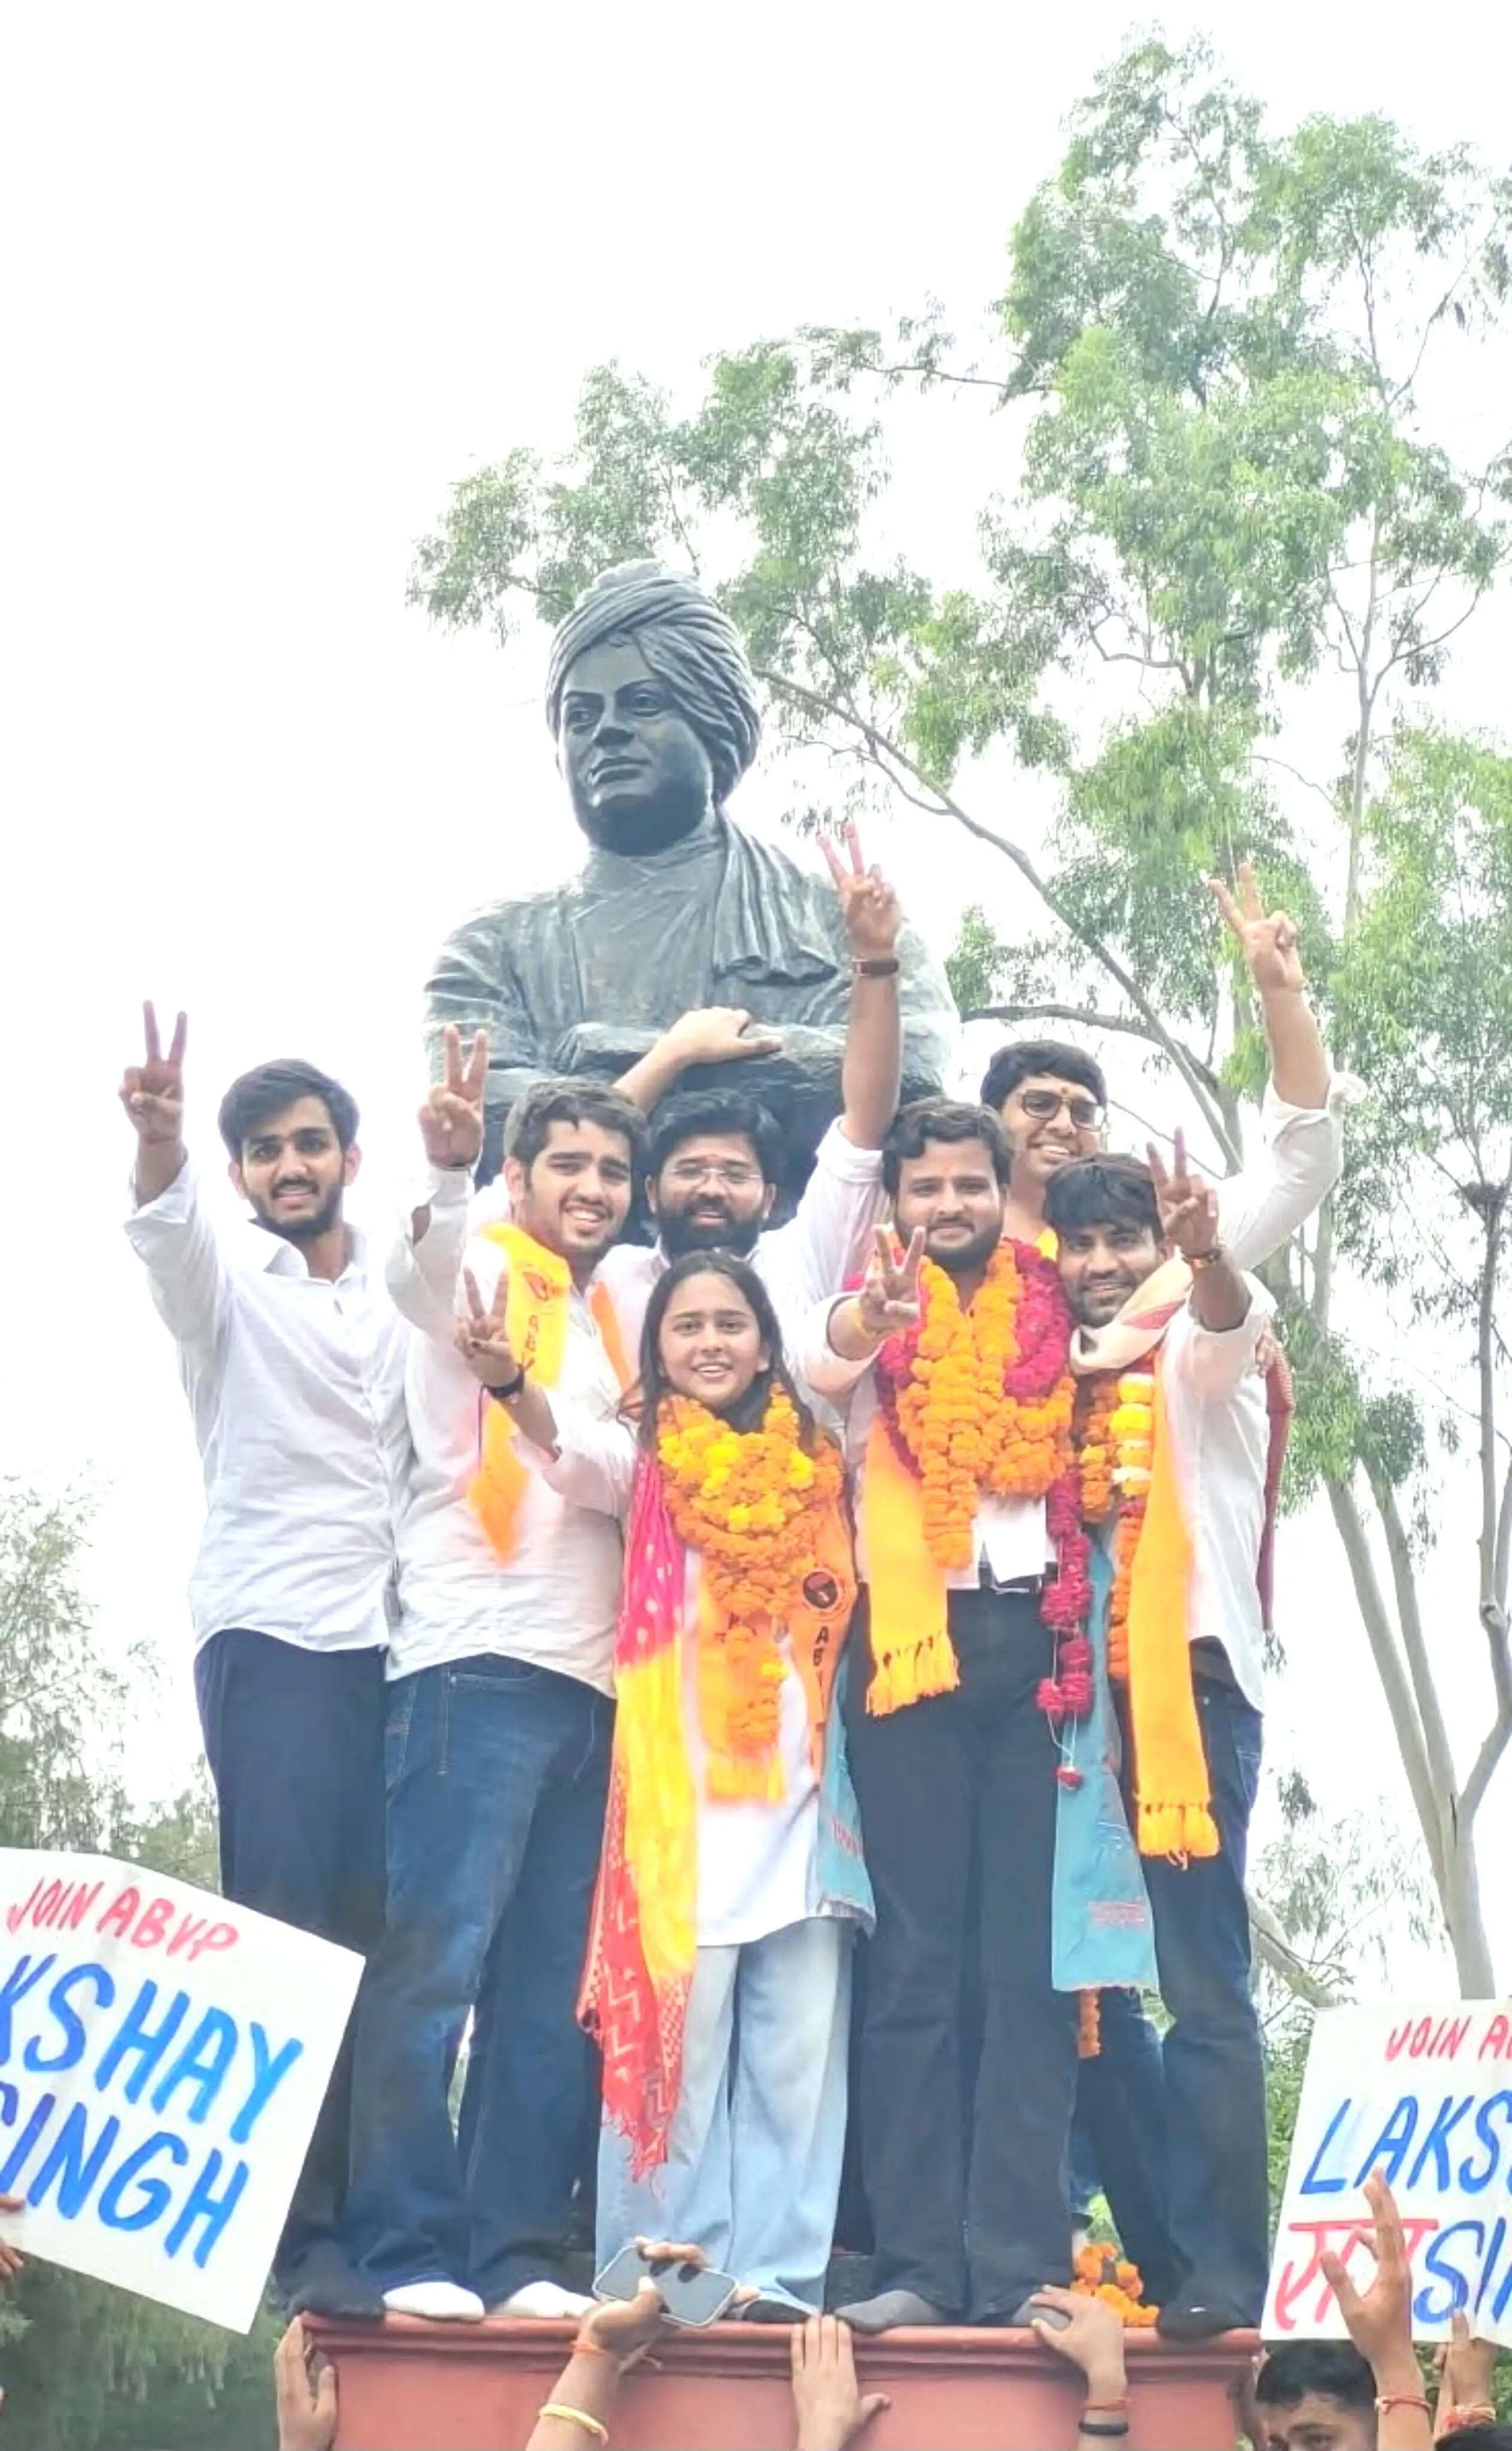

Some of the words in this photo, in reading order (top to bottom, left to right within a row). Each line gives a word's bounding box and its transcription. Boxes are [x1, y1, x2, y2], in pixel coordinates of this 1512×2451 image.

[8, 1877, 103, 1933] JOIN
[96, 1886, 239, 1962] ABVP
[0, 1953, 303, 2144] KSHAY
[1385, 2015, 1472, 2061] JOIN
[1478, 2014, 1512, 2060] A
[1300, 2090, 1512, 2194] LAKS
